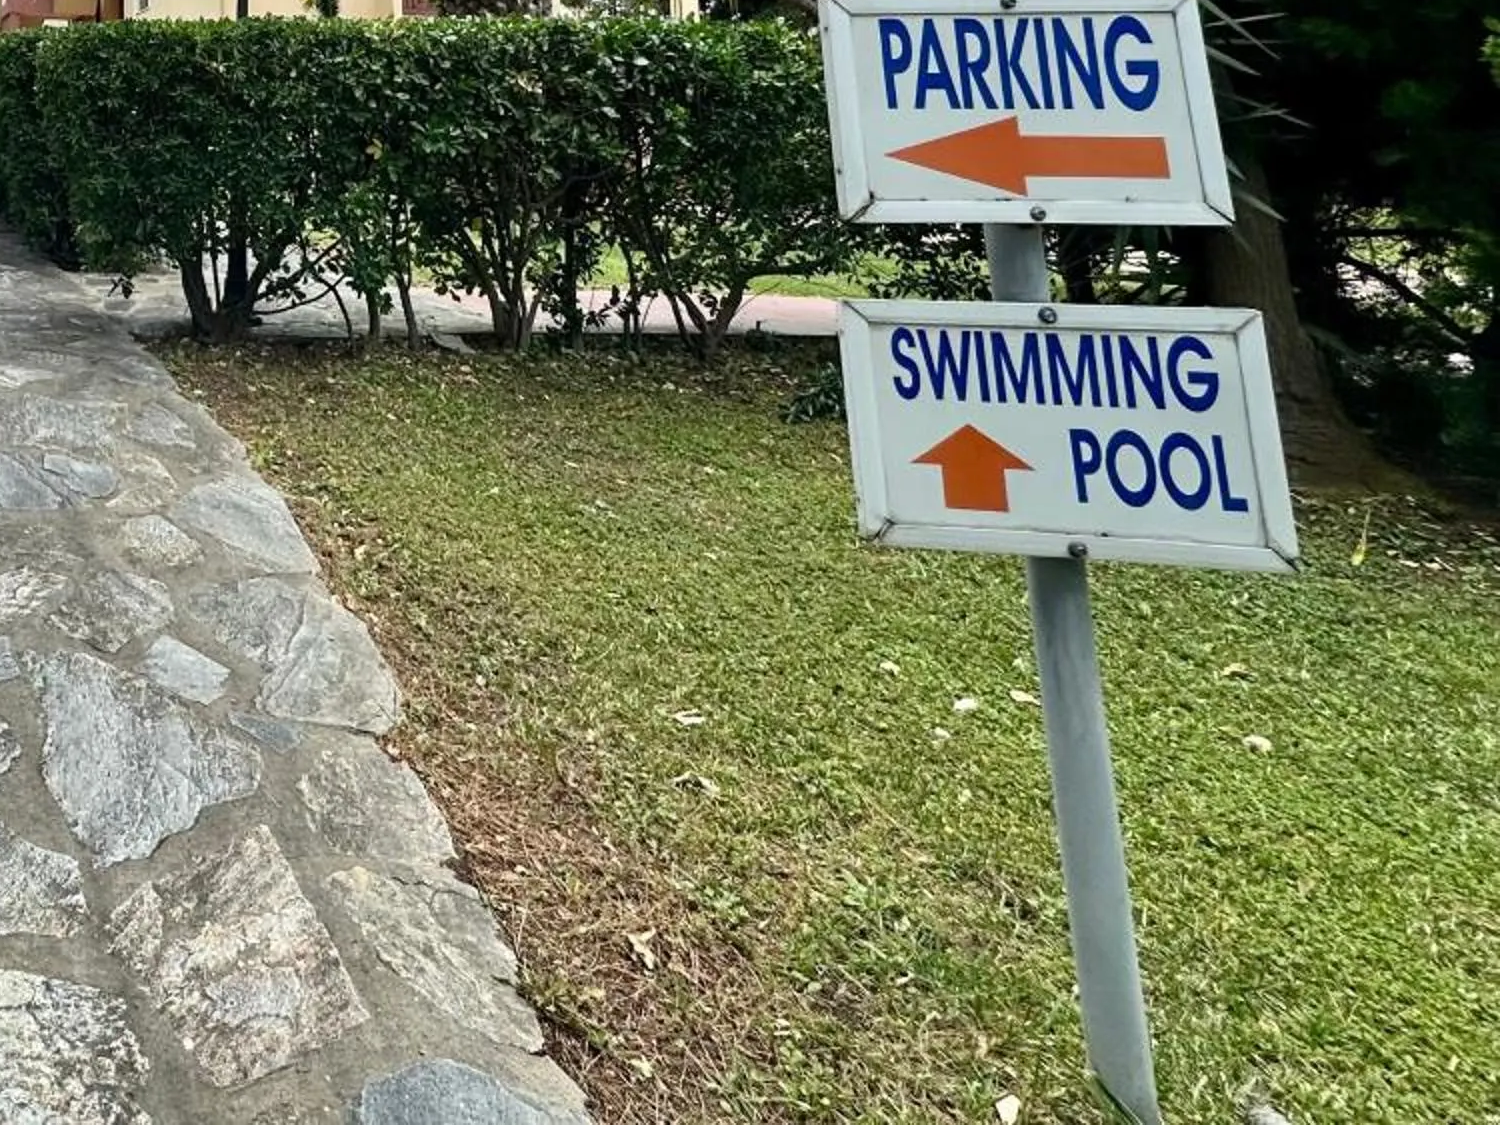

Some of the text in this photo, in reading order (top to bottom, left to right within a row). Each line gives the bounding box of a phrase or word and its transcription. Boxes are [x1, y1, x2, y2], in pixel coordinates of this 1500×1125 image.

[878, 15, 1159, 111] PARKING
[891, 327, 1219, 412] SWIMMING
[1070, 428, 1248, 512] POOL
